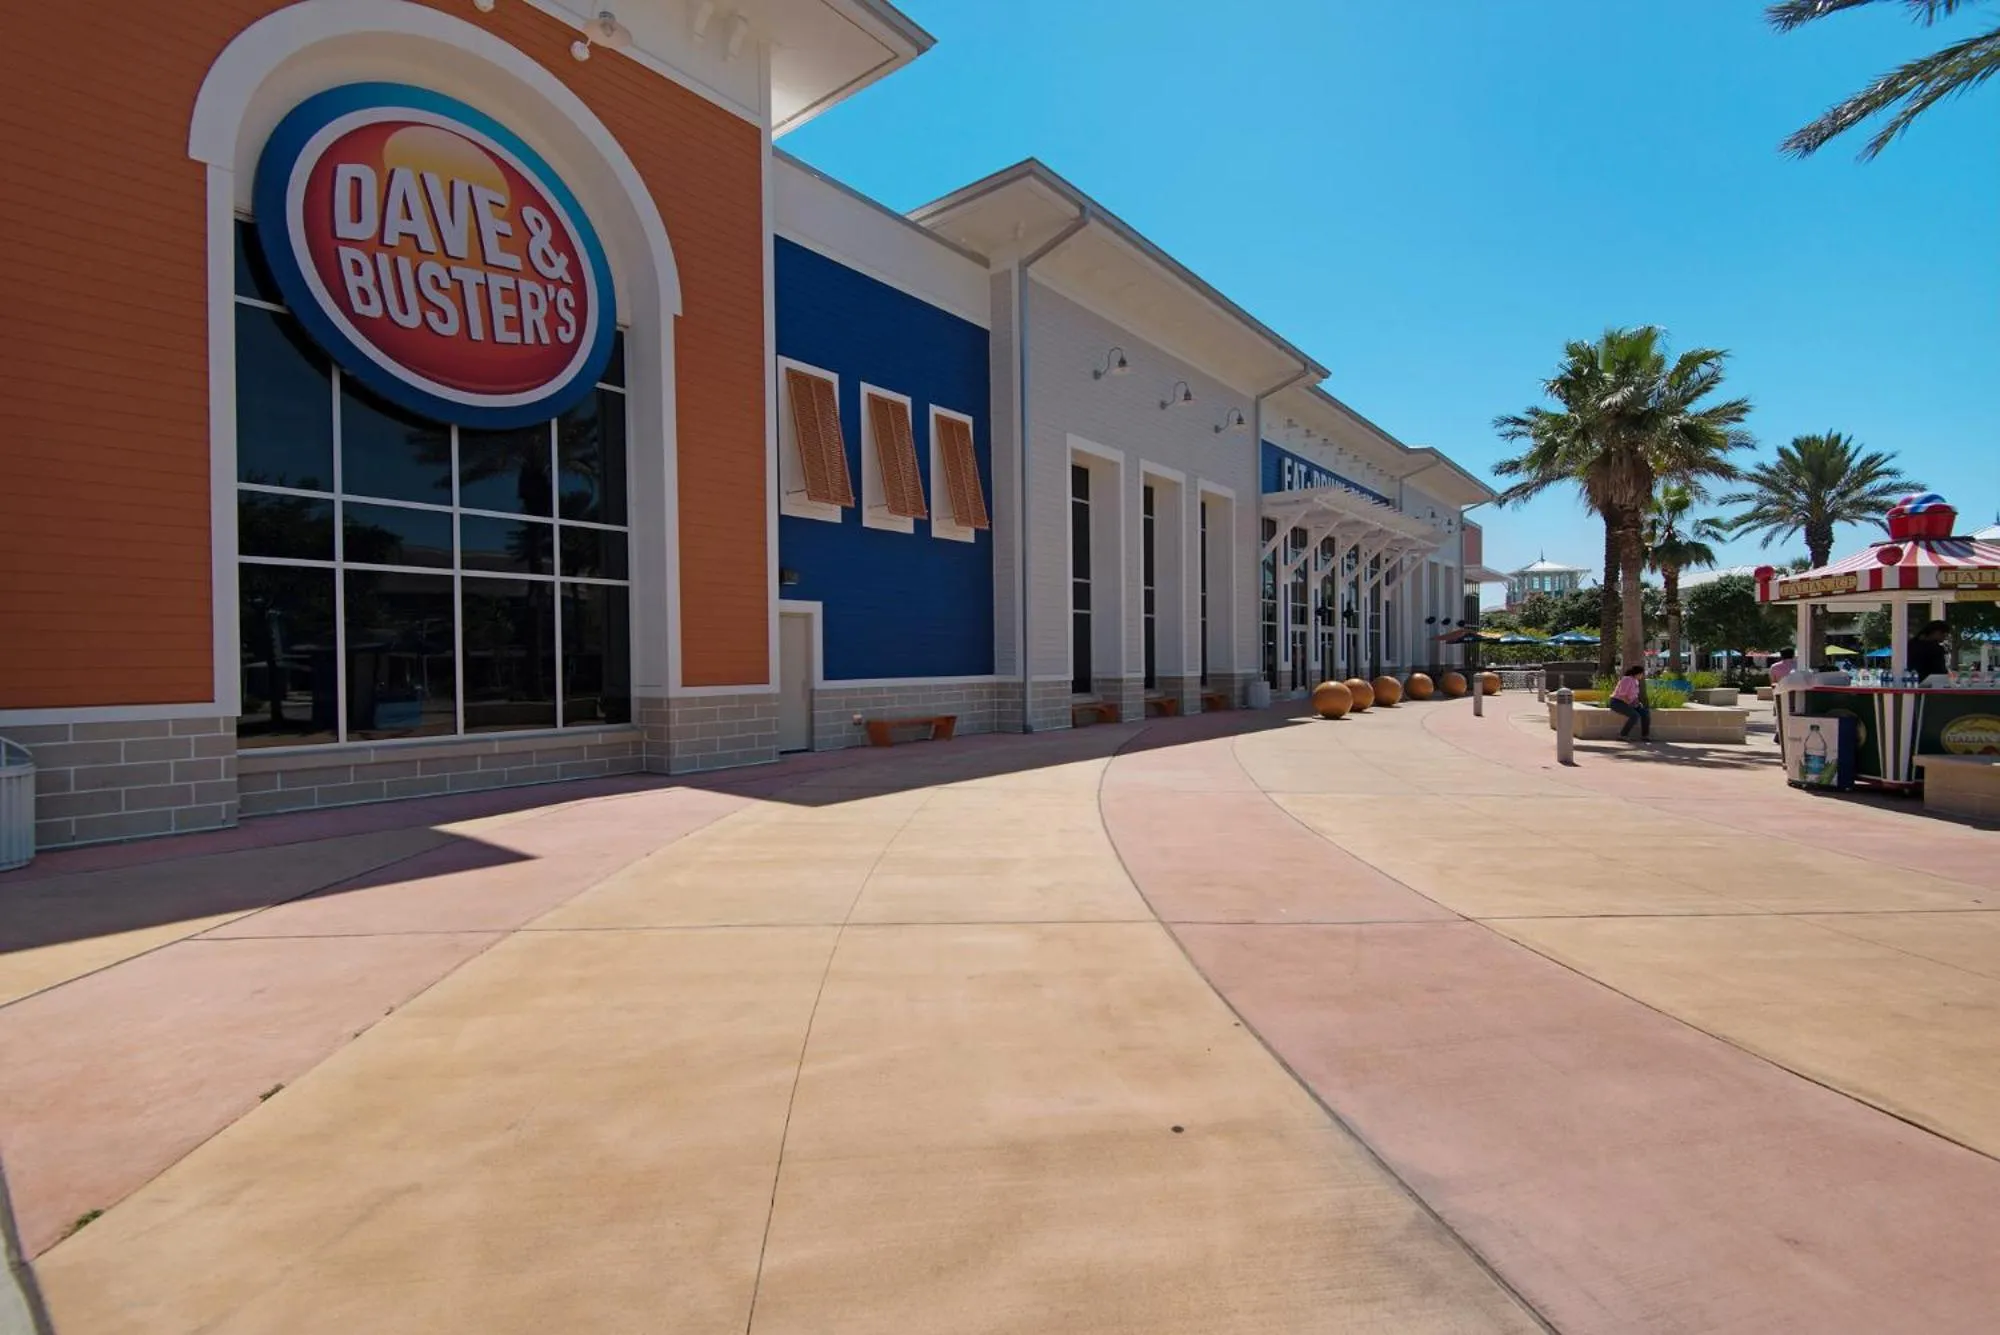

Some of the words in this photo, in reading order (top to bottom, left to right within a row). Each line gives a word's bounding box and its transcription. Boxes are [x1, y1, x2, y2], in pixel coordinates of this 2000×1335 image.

[333, 163, 522, 271] DAVE
[519, 205, 573, 284] &
[337, 244, 577, 345] BUSTER'S
[1282, 457, 1307, 491] EAT
